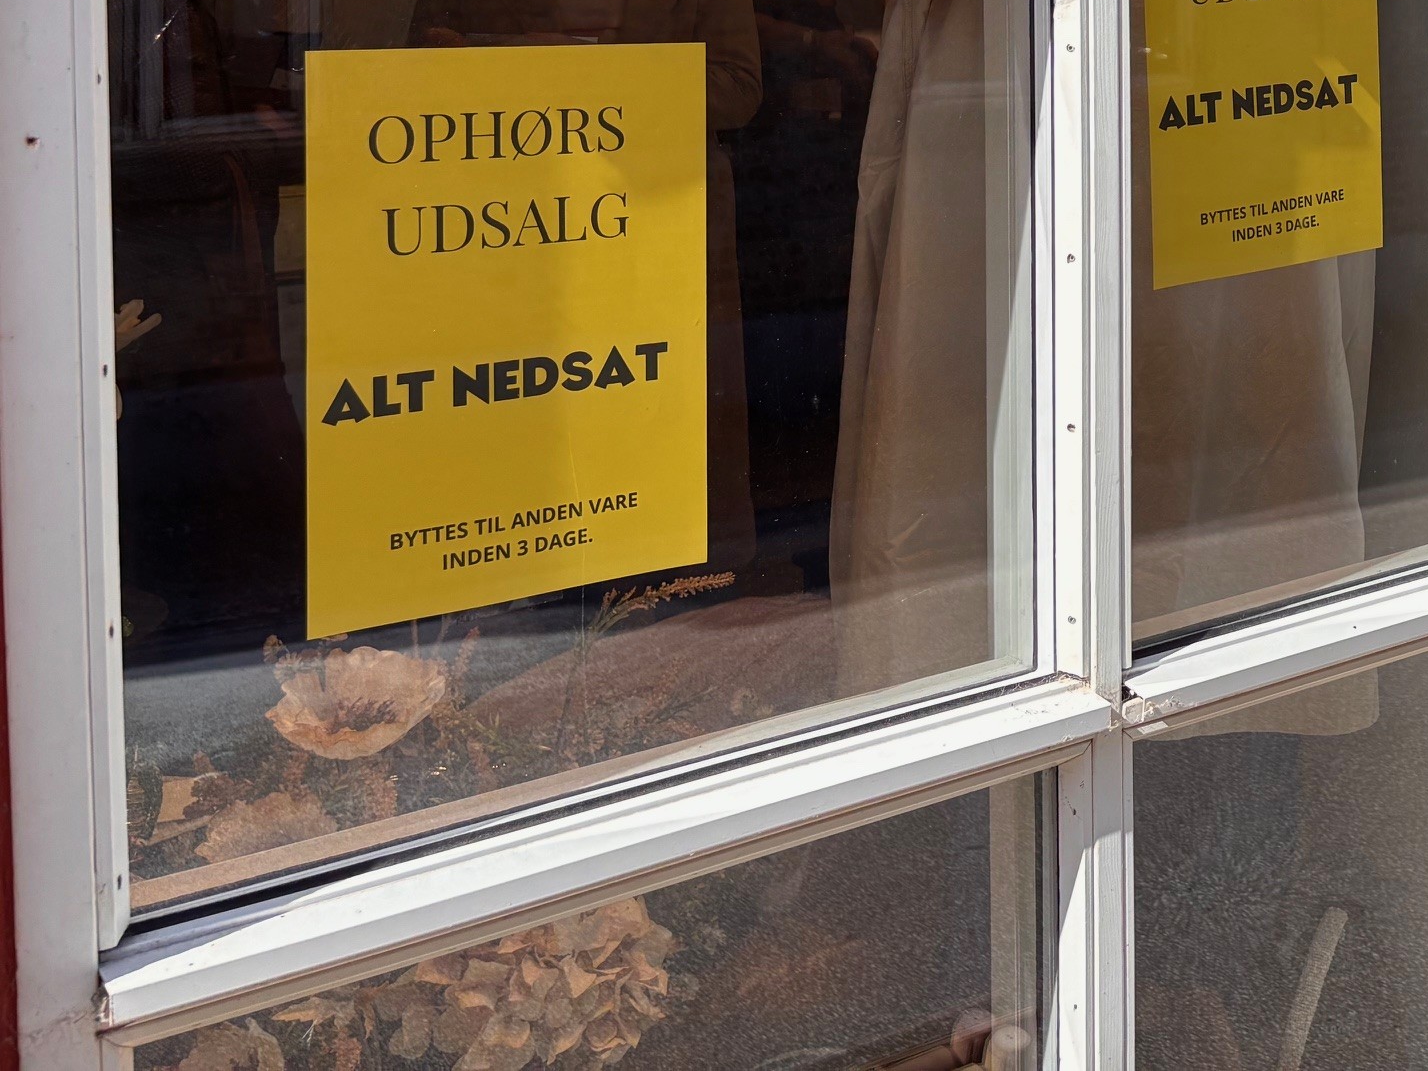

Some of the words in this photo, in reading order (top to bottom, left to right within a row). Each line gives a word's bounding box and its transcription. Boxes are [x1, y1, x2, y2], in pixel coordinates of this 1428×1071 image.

[1157, 89, 1224, 133] ALT
[1230, 72, 1359, 122] NEDSAT
[367, 105, 626, 166] OPHØRS
[381, 191, 631, 257] UDSALG
[1199, 206, 1248, 227] BYTTES
[1249, 202, 1270, 218] TIL
[1270, 194, 1314, 215] ANDEN
[1313, 188, 1346, 206] VARE
[1231, 222, 1274, 243] INDEN
[1275, 220, 1284, 236] 3
[1285, 213, 1320, 234] DAGE.
[320, 368, 436, 428] ALT
[451, 340, 669, 409] NEDSAT
[389, 520, 469, 552] BYTTES
[472, 515, 507, 537] TIL
[510, 500, 584, 531] ANDEN
[587, 490, 640, 516] VARE
[441, 541, 512, 572] INDEN
[516, 538, 530, 558] 3
[533, 526, 595, 555] DAGE.
